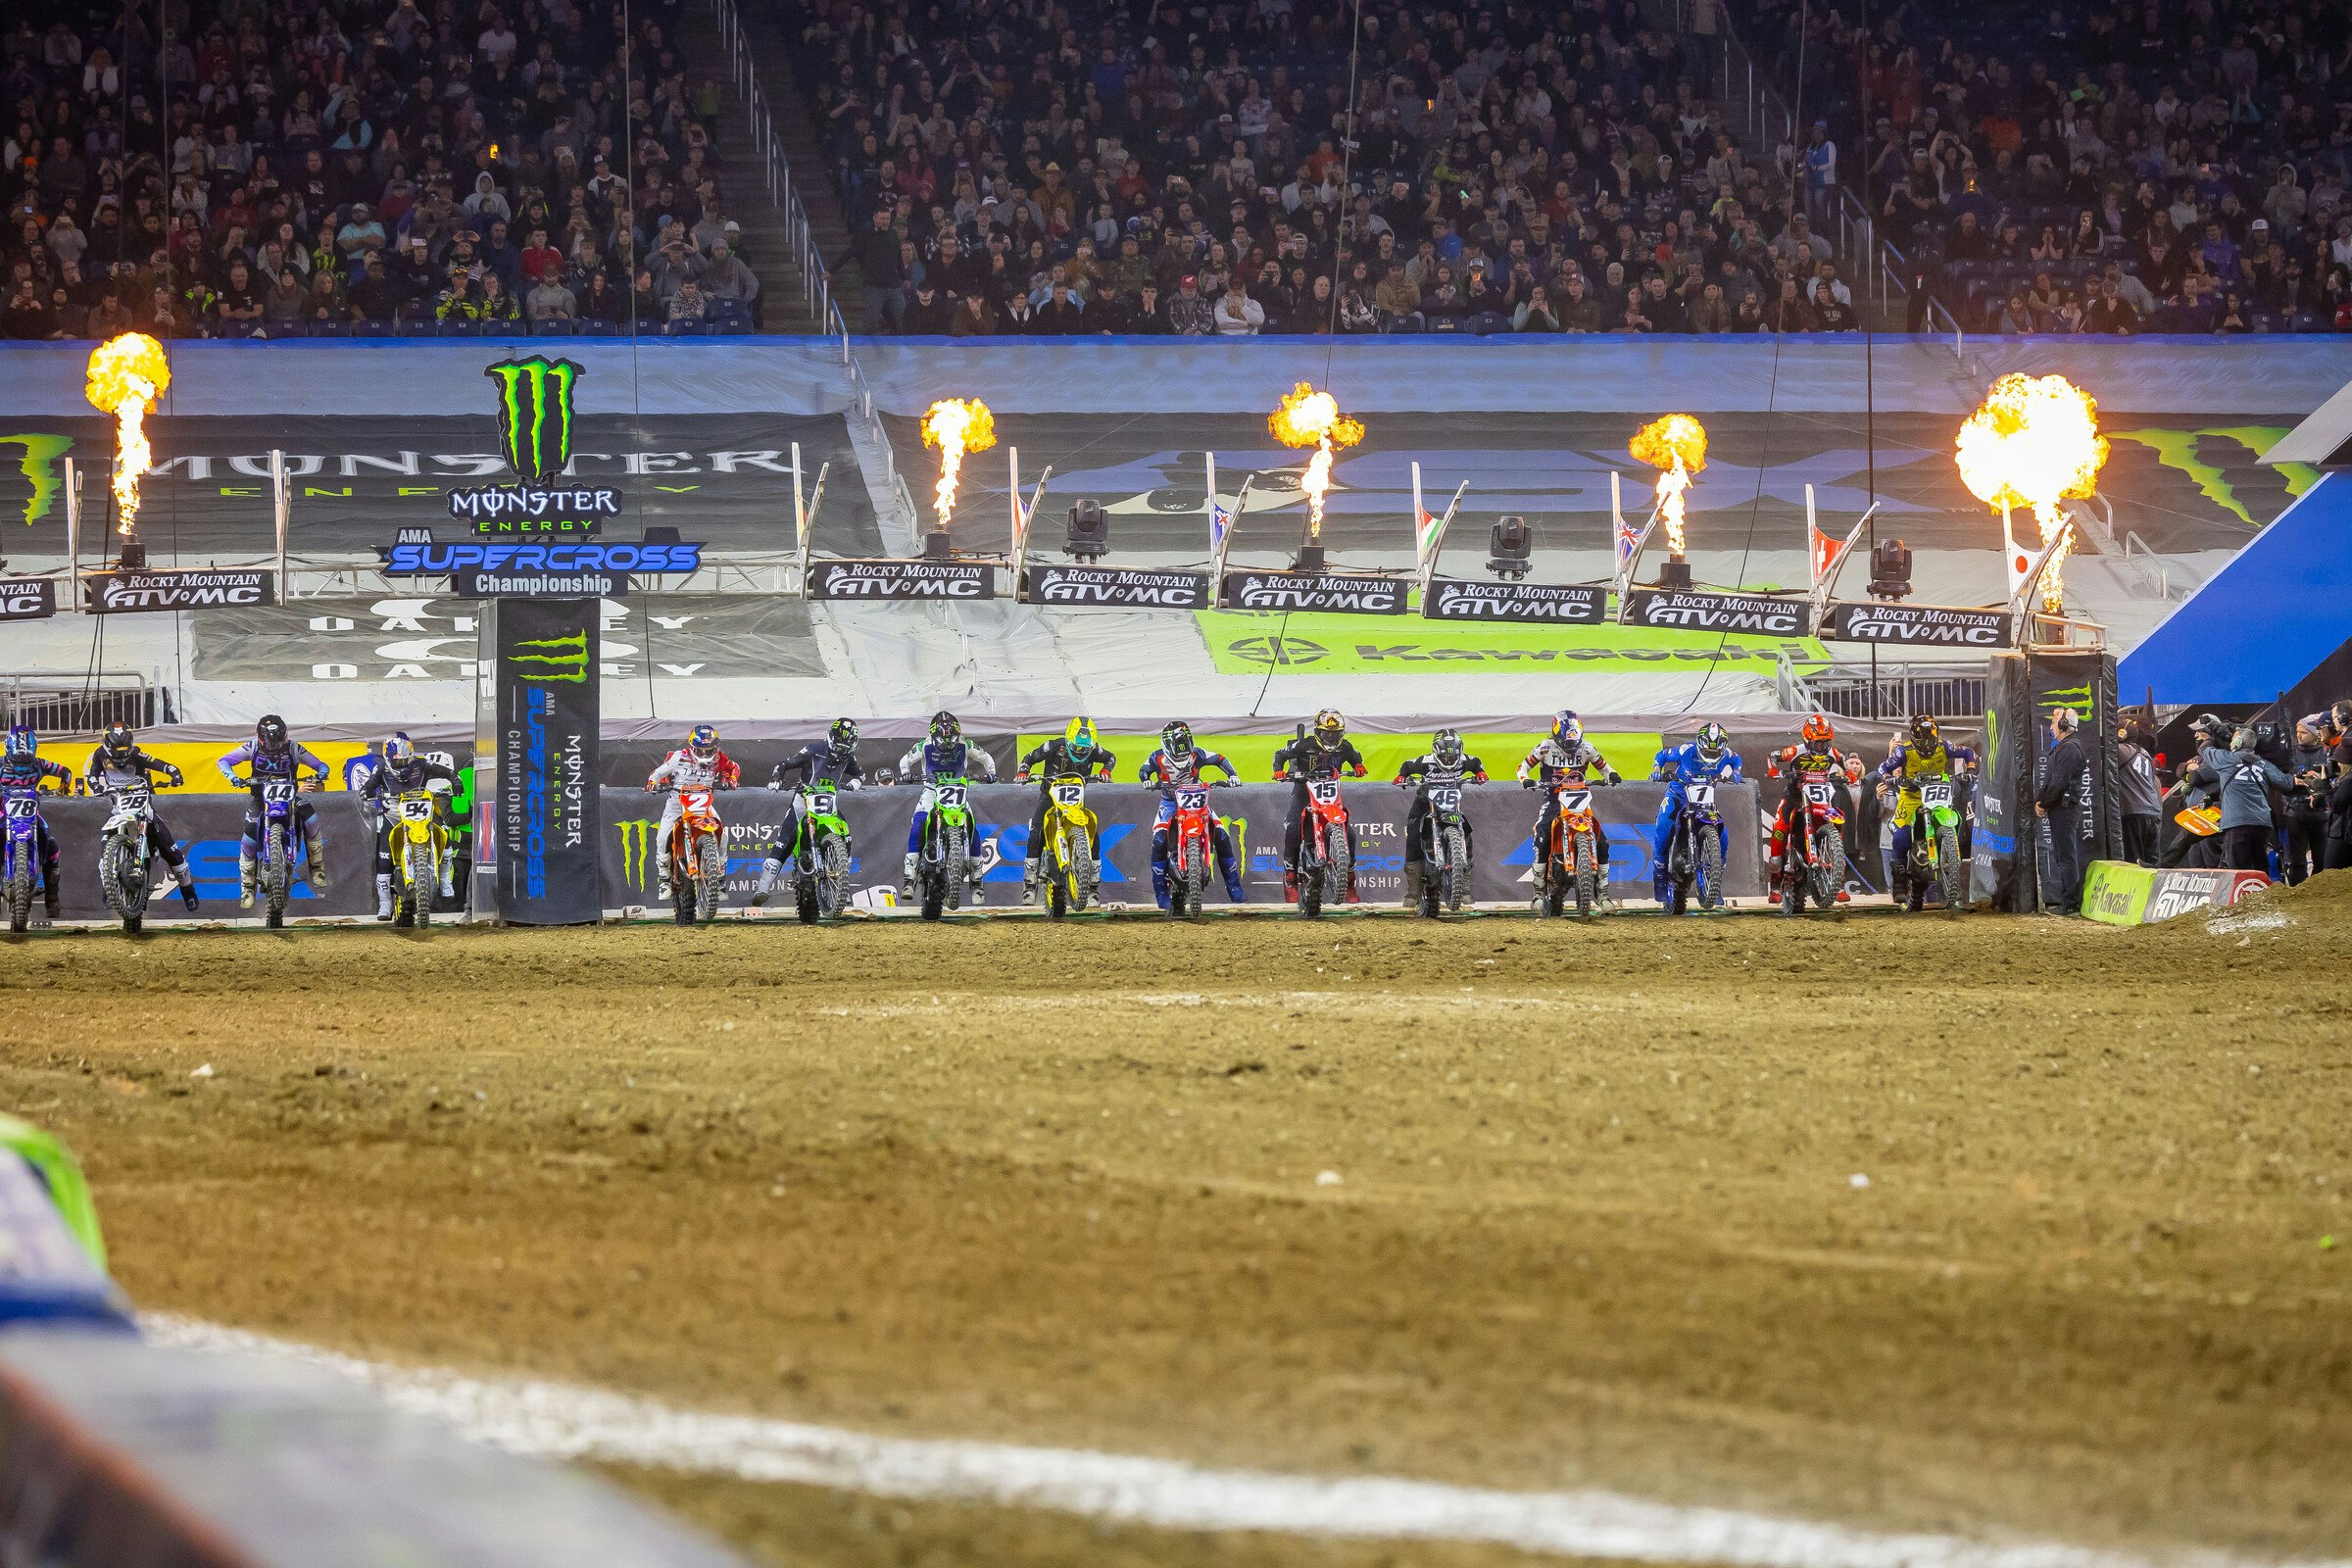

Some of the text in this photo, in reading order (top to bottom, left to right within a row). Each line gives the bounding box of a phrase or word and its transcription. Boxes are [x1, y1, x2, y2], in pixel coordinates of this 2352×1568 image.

[452, 486, 617, 516] MONSTER
[479, 519, 593, 532] ENERGY
[398, 529, 431, 543] AMA
[388, 545, 702, 571] SUPERCROSS
[128, 573, 262, 588] ROCKY MOUNTAIN
[850, 564, 983, 579] ROCKY MOUNTAIN
[1066, 568, 1198, 587] ROCKY MOUNTAIN
[475, 574, 613, 596] Championship
[1266, 575, 1396, 593] ROCKY MOUNTAIN
[1463, 583, 1593, 602] ROCKY MOUNTAIN
[1669, 594, 1798, 614] ROCKY MOUNTAIN
[1873, 607, 2001, 627] ROCKY MOUNTAIN
[1354, 643, 1810, 662] Kawasaki
[545, 692, 556, 716] AMA
[2132, 756, 2150, 776] 41
[2234, 763, 2265, 783] 25
[267, 785, 293, 802] 44
[508, 730, 521, 853] CHAMPIONSHIP
[527, 685, 546, 900] SUPERCROSS
[564, 734, 582, 849] MONSTER
[939, 787, 965, 806] 21
[1057, 787, 1081, 803] 12
[1313, 783, 1337, 799] 15
[1433, 790, 1459, 806] 46
[1696, 786, 1708, 803] 1
[1809, 785, 1831, 803] 51
[1925, 786, 1951, 801] 68
[9, 799, 36, 817] 78
[687, 794, 710, 812] 2
[814, 795, 834, 814] 9
[1181, 793, 1206, 809] 23
[1565, 792, 1589, 809] 7
[2080, 759, 2094, 842] ONSTER
[405, 802, 429, 818] 94
[1255, 846, 1278, 856] AMA
